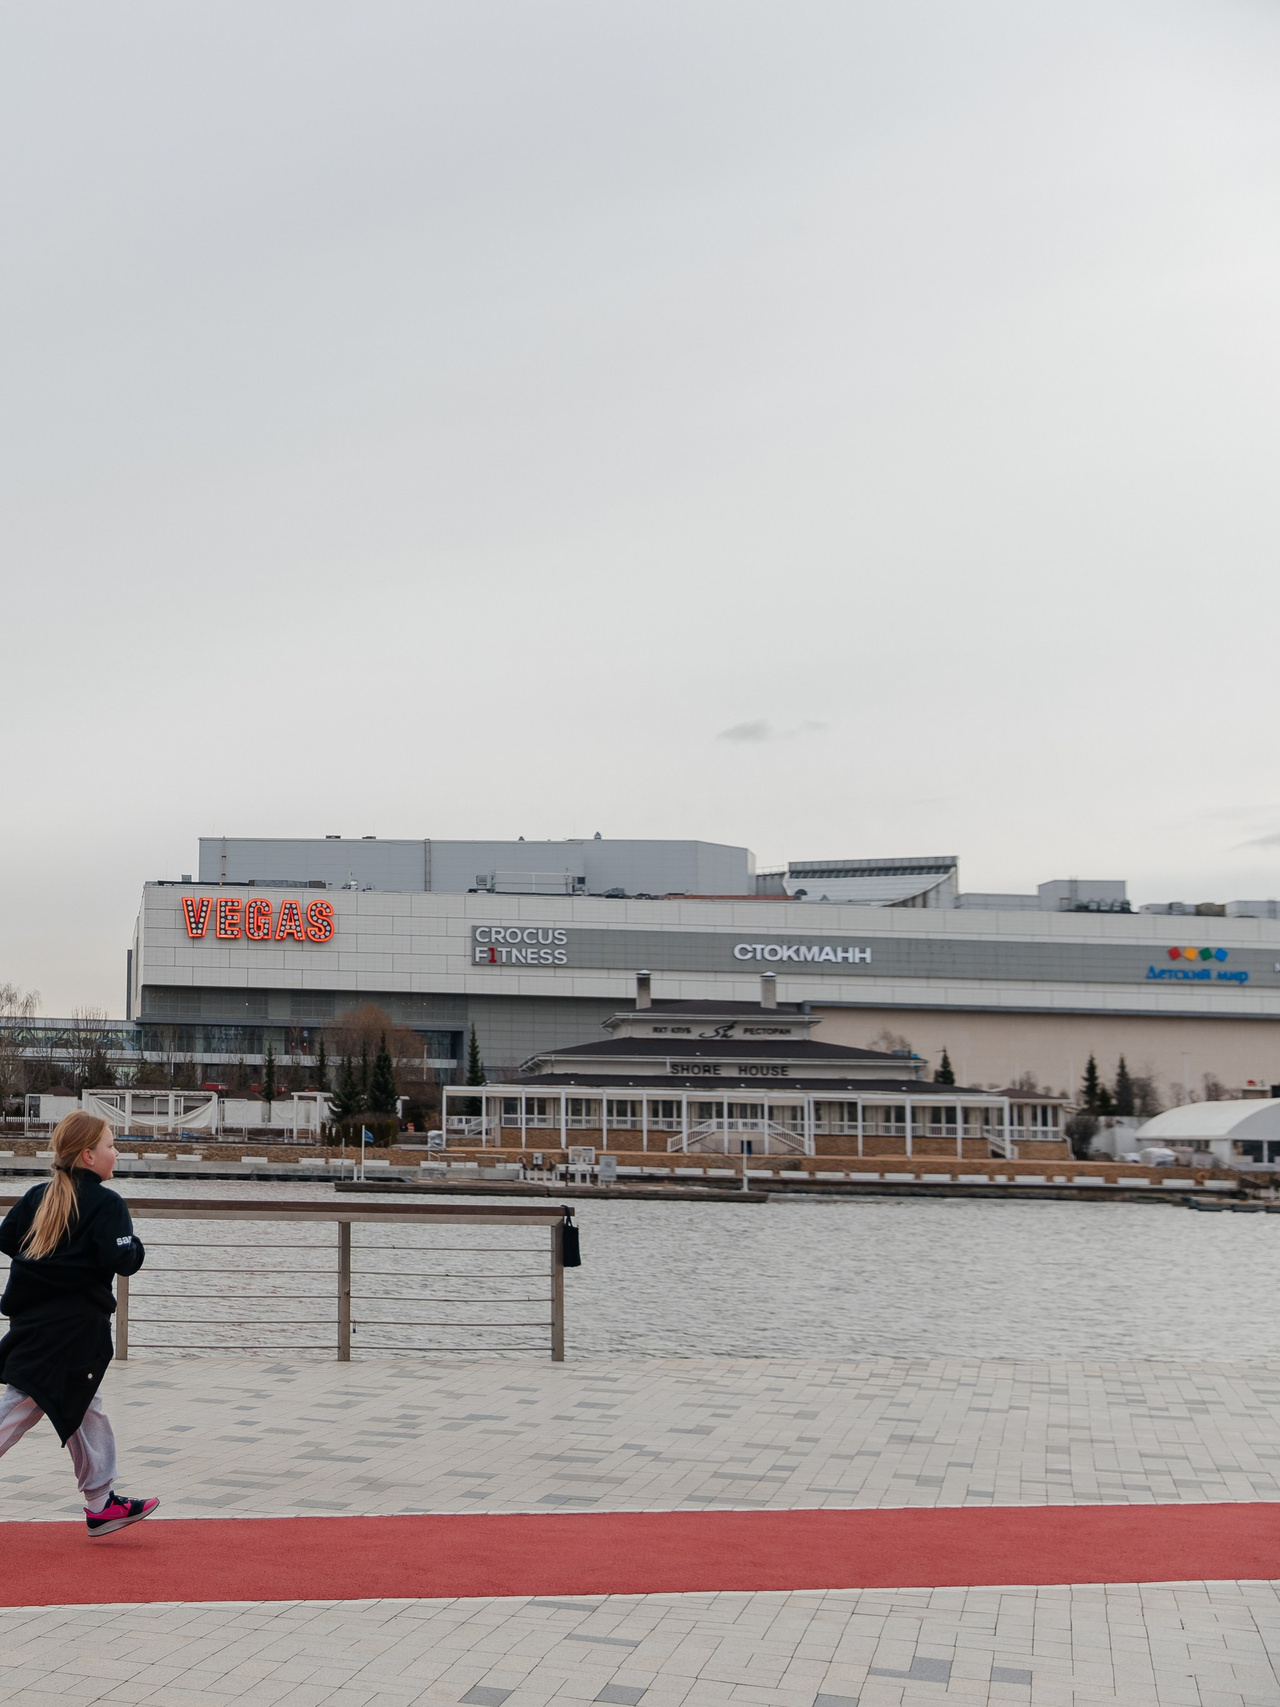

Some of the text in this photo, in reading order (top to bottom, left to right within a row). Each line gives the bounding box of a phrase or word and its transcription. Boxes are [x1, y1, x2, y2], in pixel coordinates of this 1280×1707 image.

[181, 897, 335, 943] VEGAS
[475, 927, 568, 945] CROCUS
[475, 947, 568, 965] F1TNESS
[733, 943, 872, 963] СТОКМАНН
[1146, 965, 1249, 985] Детский мир
[743, 1027, 791, 1036] РЕСТОРАН
[671, 1064, 789, 1077] SHORE HOUSE
